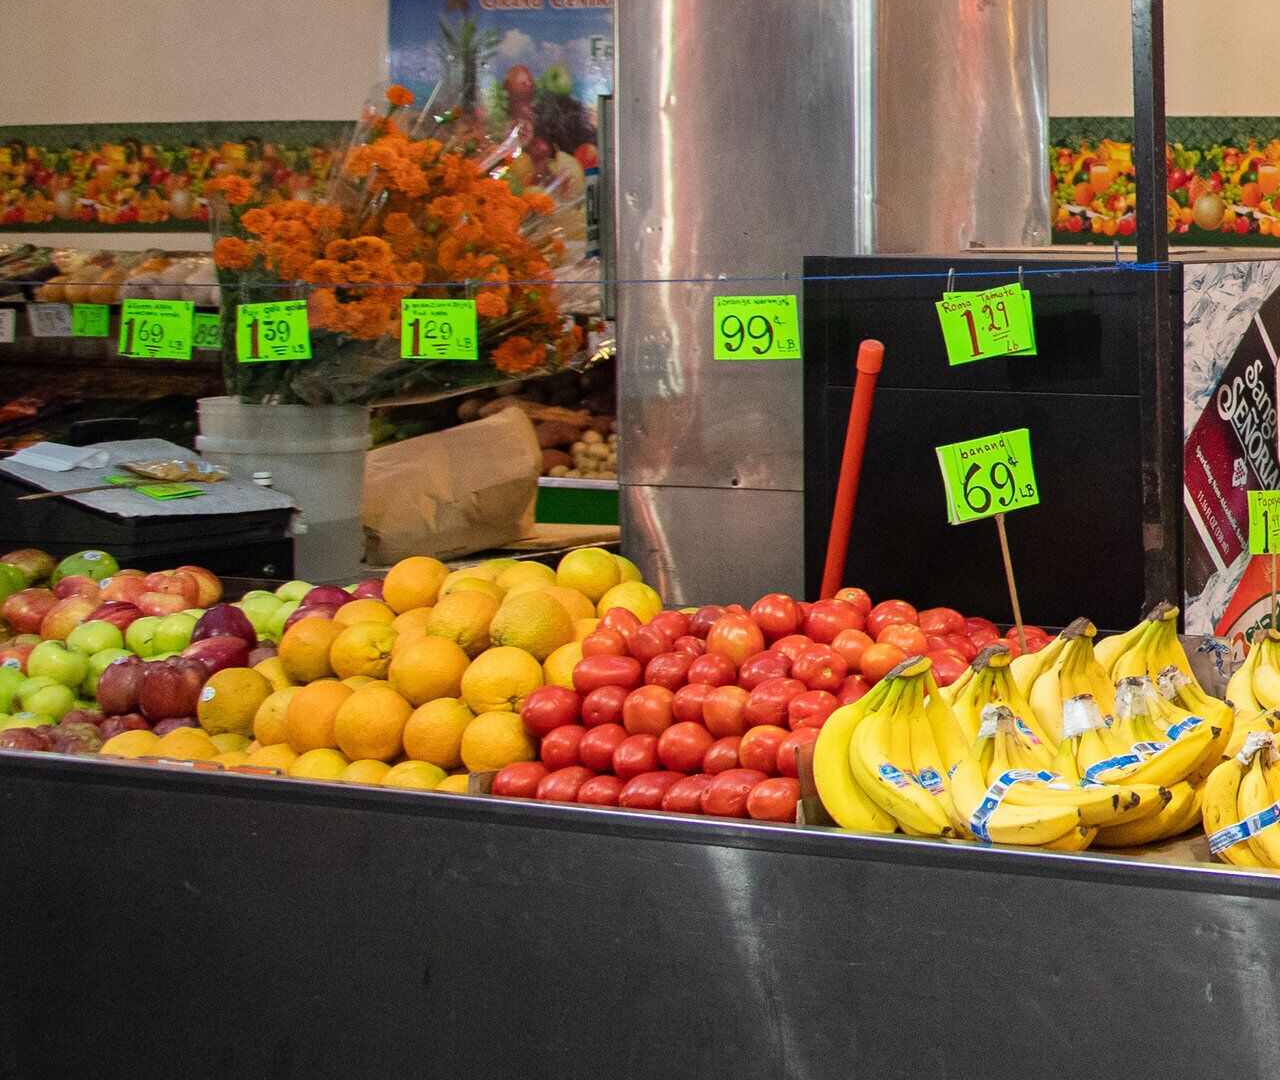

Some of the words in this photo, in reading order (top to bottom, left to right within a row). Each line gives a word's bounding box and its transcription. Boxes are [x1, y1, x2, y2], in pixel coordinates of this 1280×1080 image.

[941, 299, 973, 314] Roma
[776, 339, 798, 351] LB
[960, 439, 1006, 459] banana
[1195, 444, 1214, 482] Sparkling
[1019, 484, 1035, 498] LB
